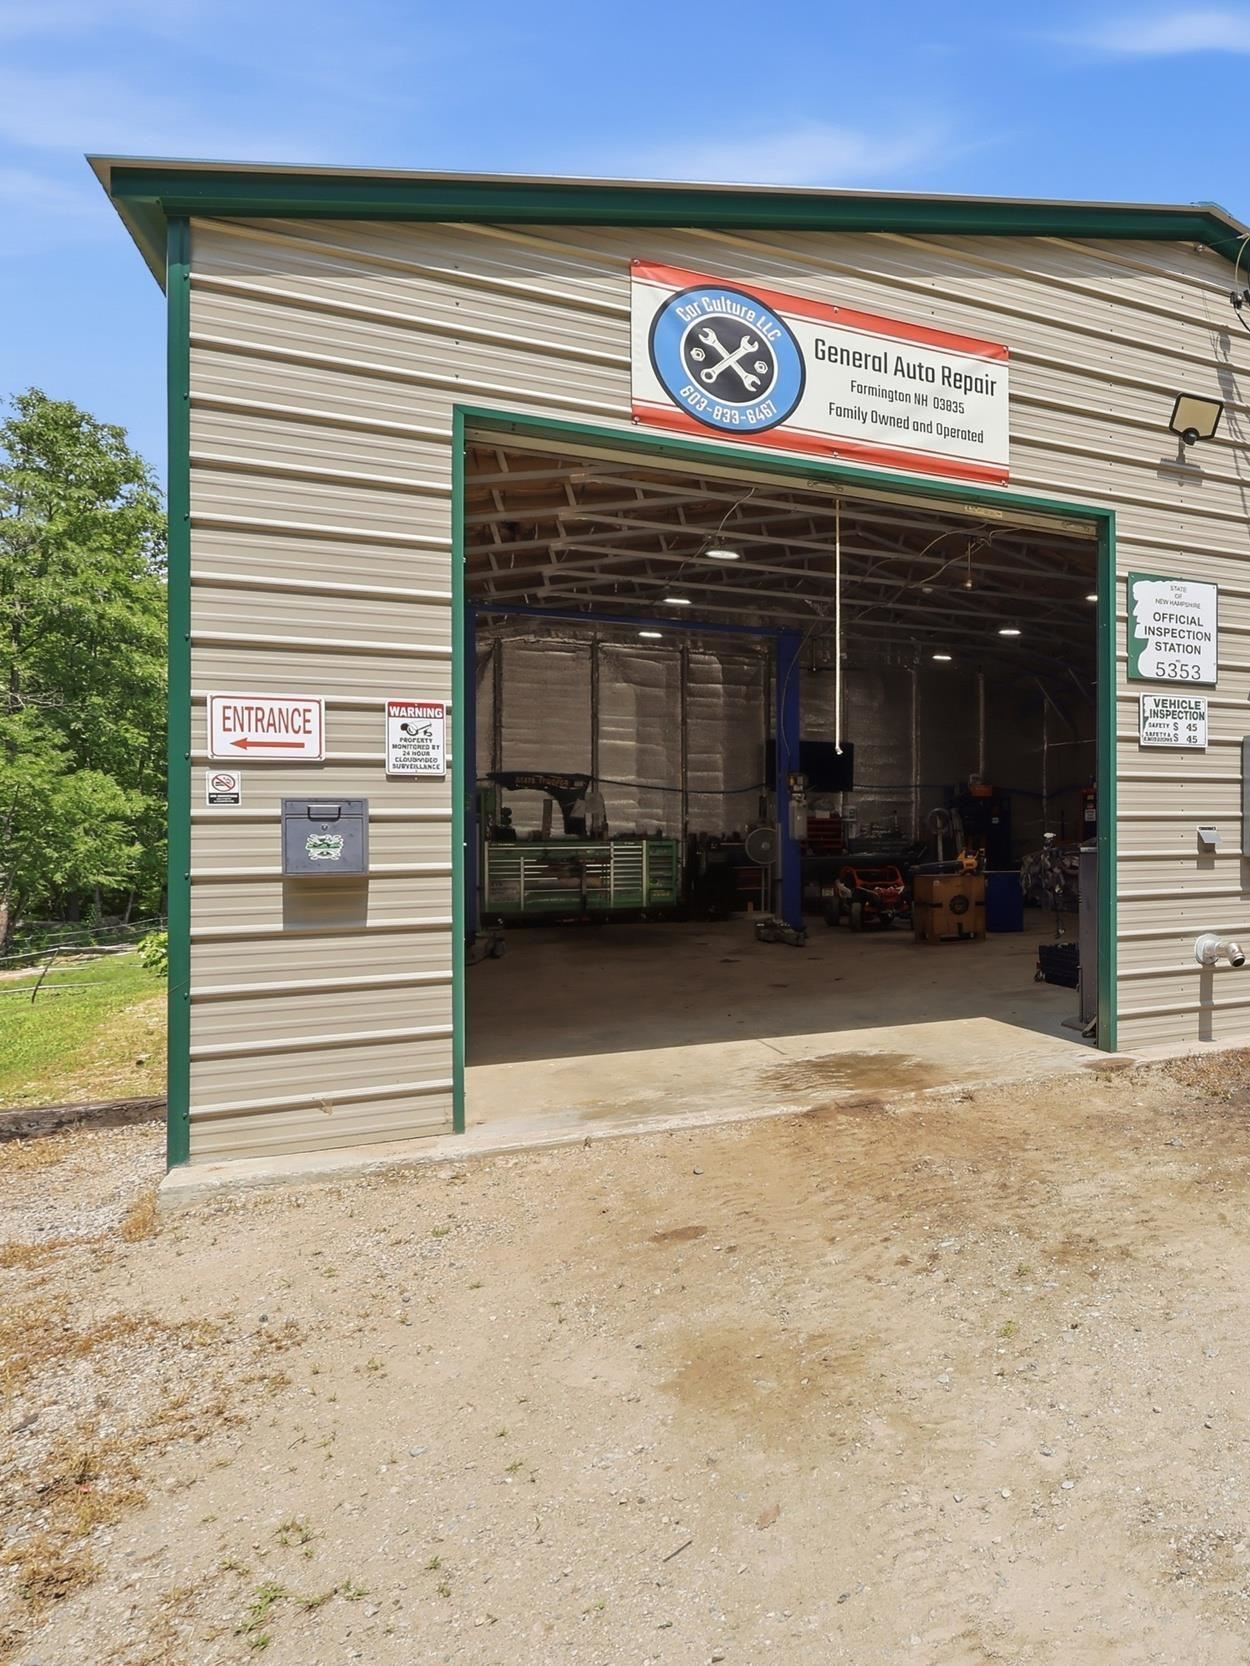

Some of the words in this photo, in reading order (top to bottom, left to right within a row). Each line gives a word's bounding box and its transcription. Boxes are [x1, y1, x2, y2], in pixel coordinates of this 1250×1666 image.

[675, 302, 702, 322] Car
[701, 296, 756, 321] Culture
[756, 316, 782, 341] LLC
[814, 338, 888, 374] General
[893, 356, 935, 384] Auto
[941, 365, 997, 396] Repair
[680, 385, 778, 425] 603-833-6467
[850, 380, 911, 404] Farmington
[914, 392, 928, 407] NH
[933, 397, 965, 414] 03835
[829, 402, 868, 424] Family
[871, 410, 910, 430] Owned
[912, 420, 933, 434] and
[936, 423, 984, 443] Operated
[1153, 611, 1204, 627] OFFICIAL
[1144, 625, 1211, 642] INSPECTION
[1155, 641, 1201, 655] STATION
[1155, 661, 1201, 680] 5353
[389, 706, 443, 718] WARNING
[1153, 698, 1201, 710] VEHICLE
[222, 705, 312, 735] ENTRANCE
[1149, 708, 1205, 720] INSPECTION
[1186, 723, 1198, 732] 45
[1186, 735, 1198, 743] 45
